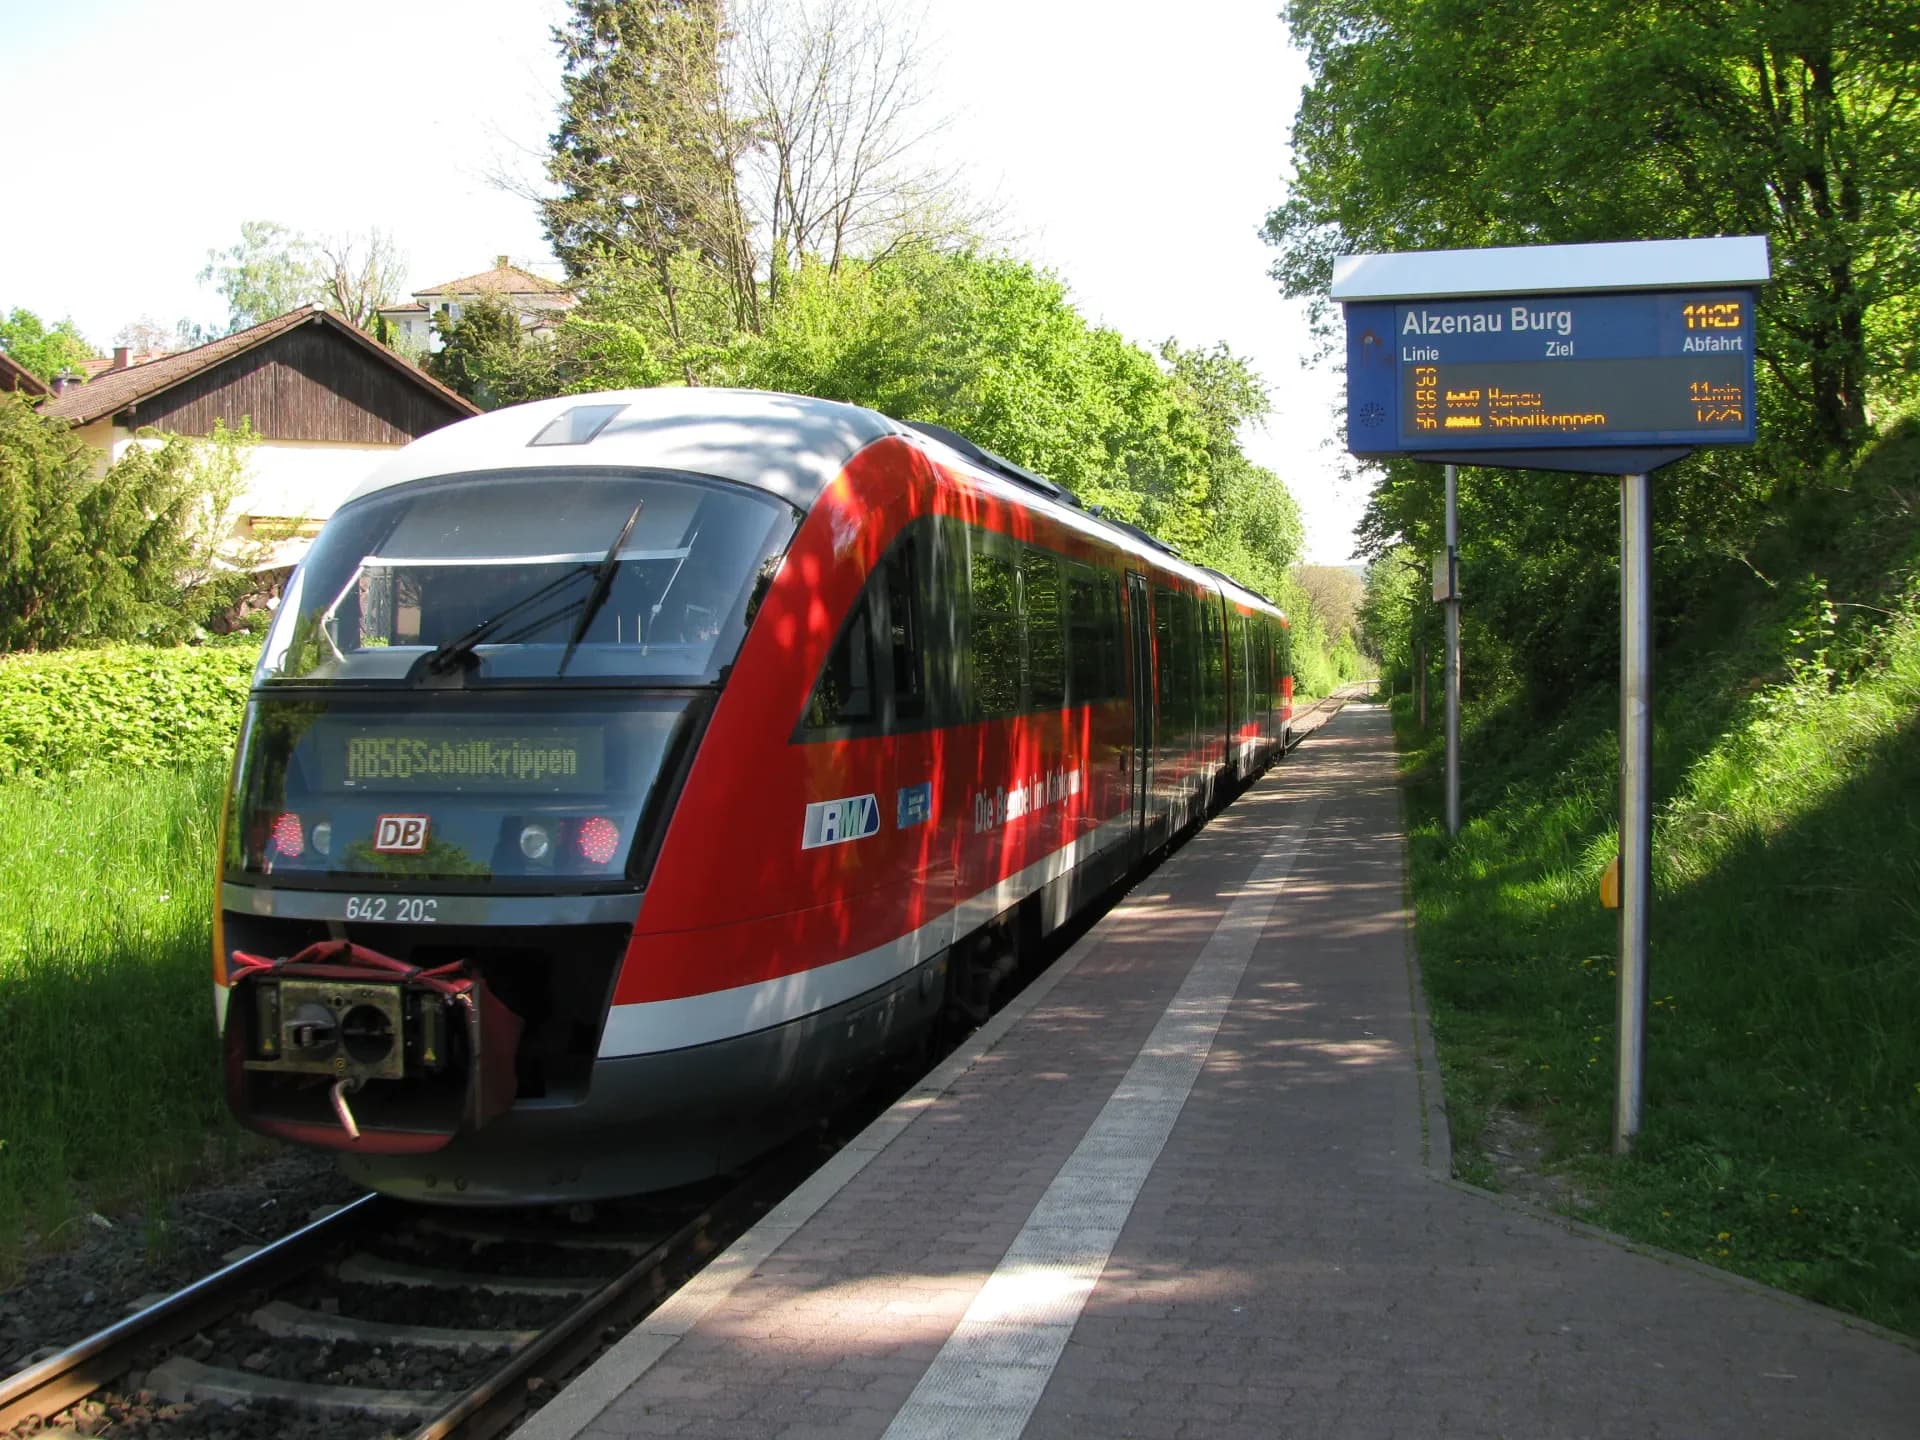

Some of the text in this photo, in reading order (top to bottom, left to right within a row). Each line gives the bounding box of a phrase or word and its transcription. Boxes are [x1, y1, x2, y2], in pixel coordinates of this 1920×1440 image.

[1402, 306, 1572, 336] Alzenau Burg
[1683, 303, 1740, 328] 11:25
[1402, 346, 1440, 361] Linie
[1545, 341, 1574, 357] Ziel
[1683, 335, 1743, 352] Abfahrt
[1488, 387, 1542, 407] Hanau
[820, 797, 874, 842] RMV
[975, 788, 994, 834] Die
[379, 820, 422, 847] DB
[346, 897, 387, 921] 642
